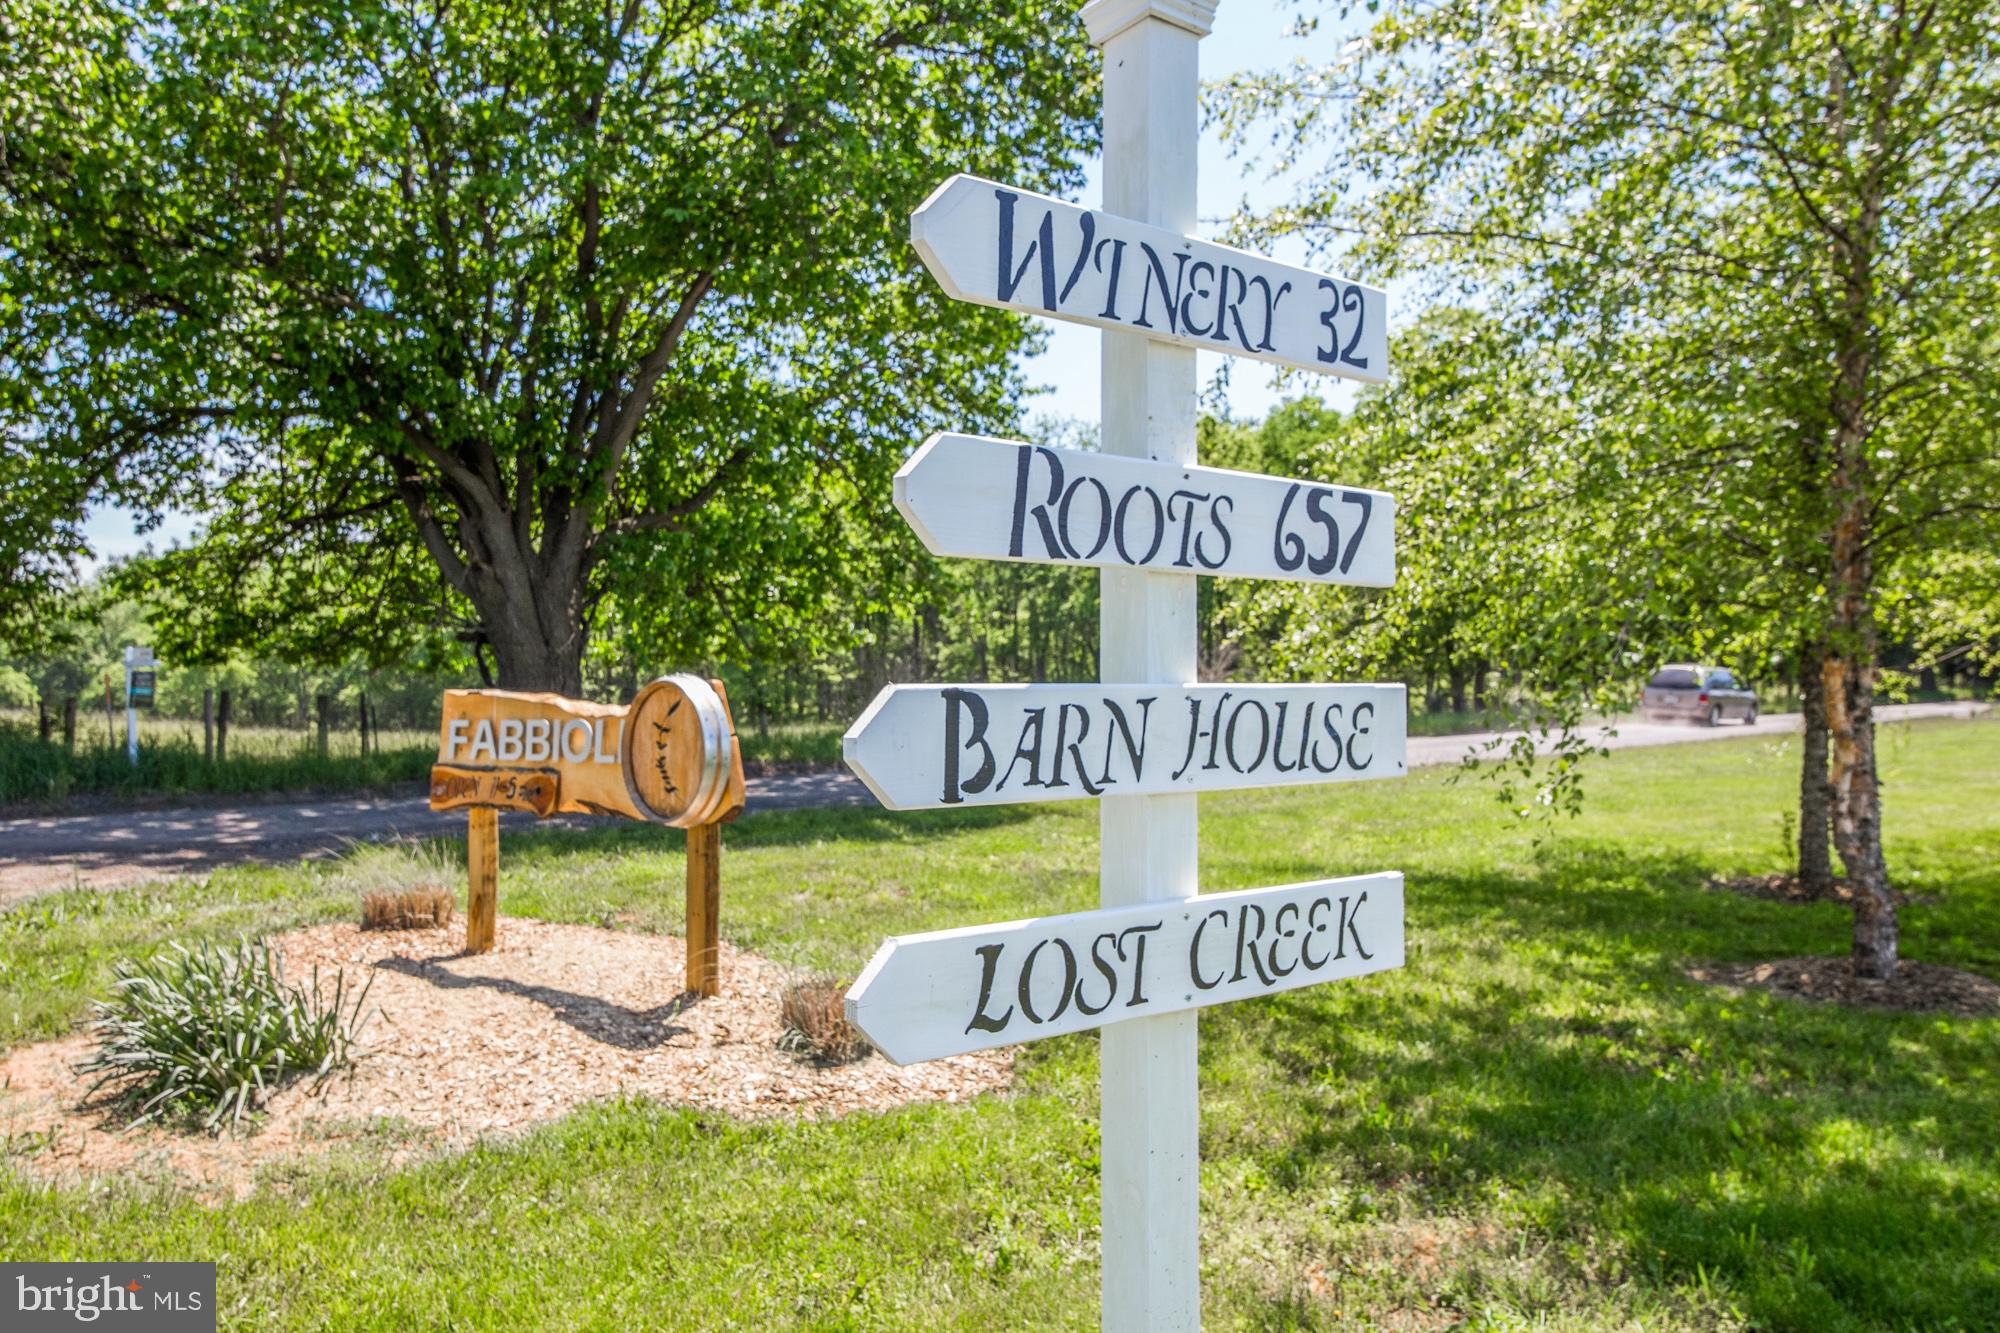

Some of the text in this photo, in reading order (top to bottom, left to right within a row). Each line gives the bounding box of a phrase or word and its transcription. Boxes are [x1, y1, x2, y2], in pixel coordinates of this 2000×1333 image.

[996, 190, 1368, 369] WINERY 32
[1008, 446, 1372, 575] ROOTS 657
[940, 688, 1374, 803] BARN HOUSE
[965, 891, 1374, 1035] LOST CREEK
